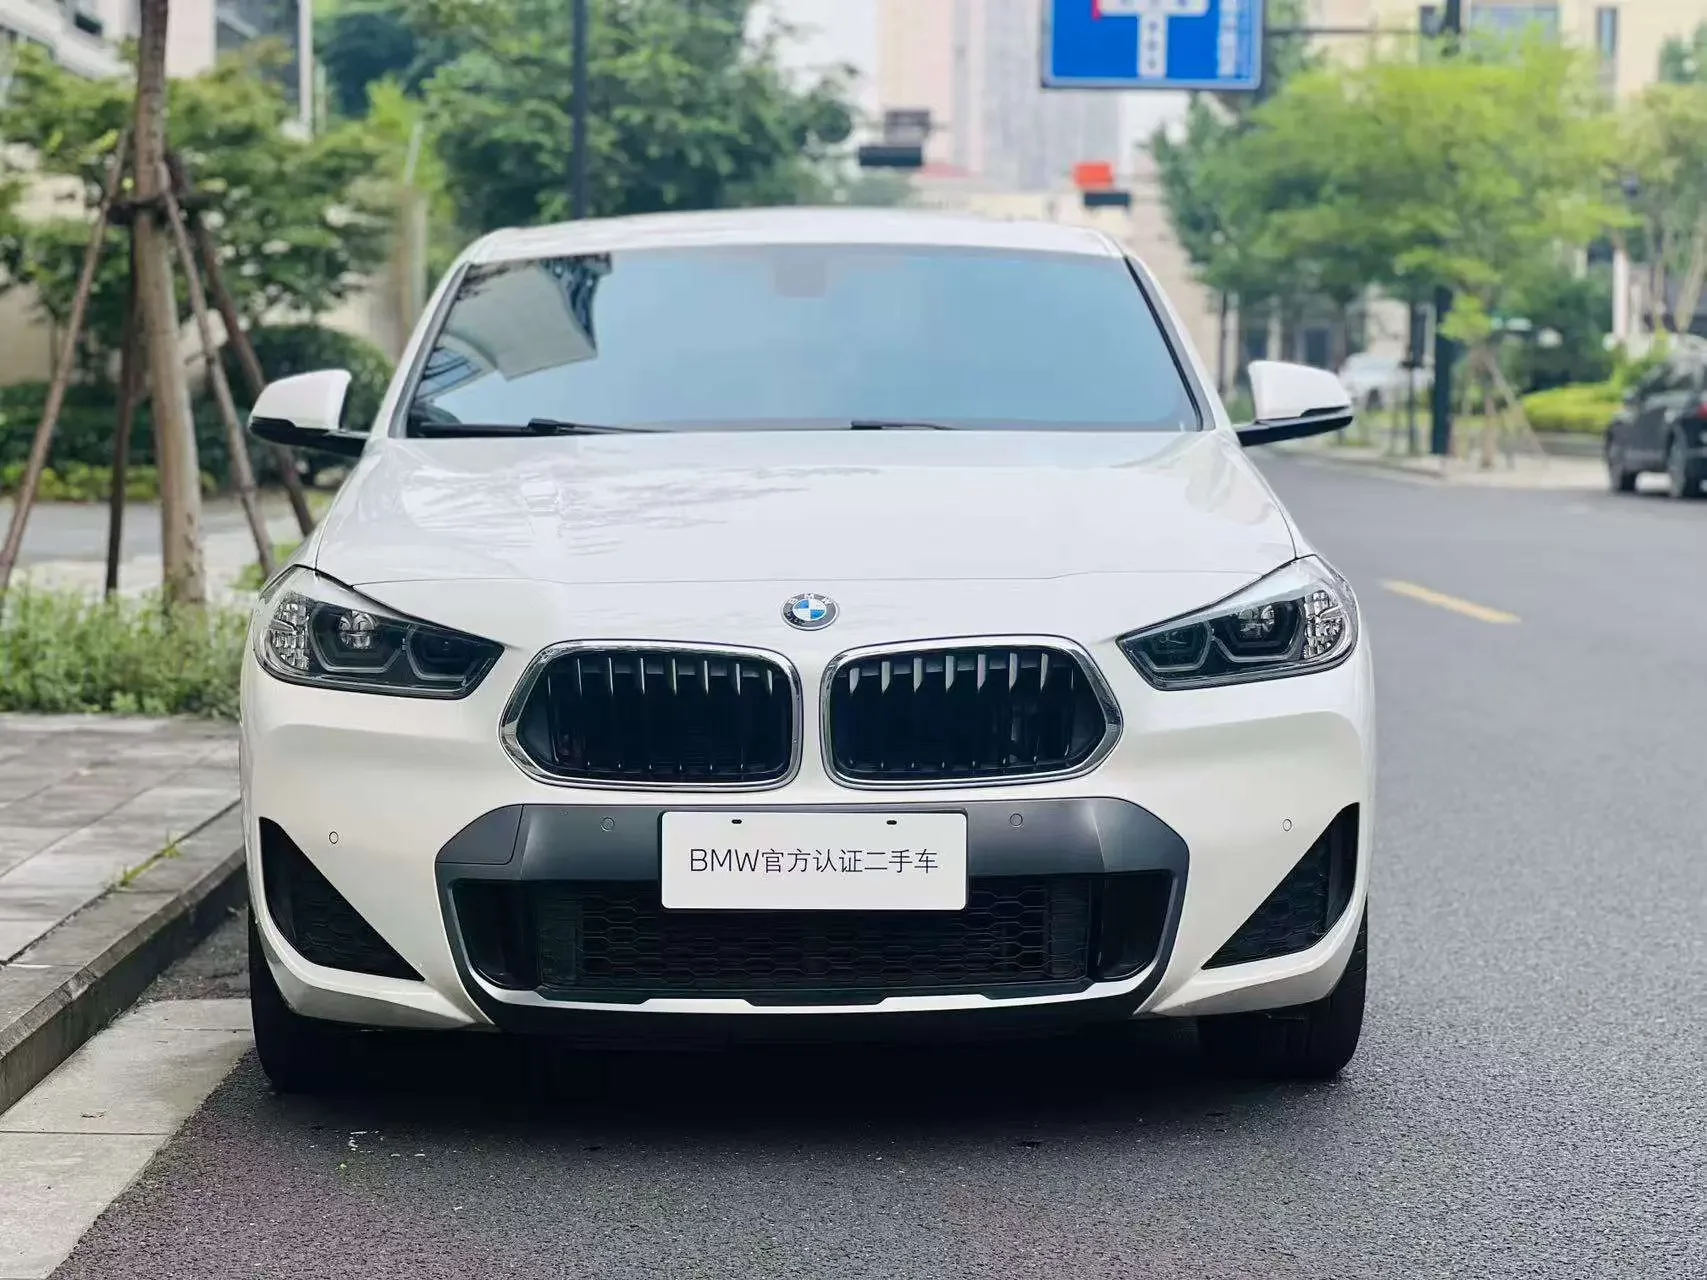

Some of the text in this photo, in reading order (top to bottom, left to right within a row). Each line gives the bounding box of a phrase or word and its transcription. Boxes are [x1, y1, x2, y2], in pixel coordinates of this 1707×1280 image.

[787, 592, 833, 605] BMW
[690, 848, 939, 874] BMW官方认证二手车
